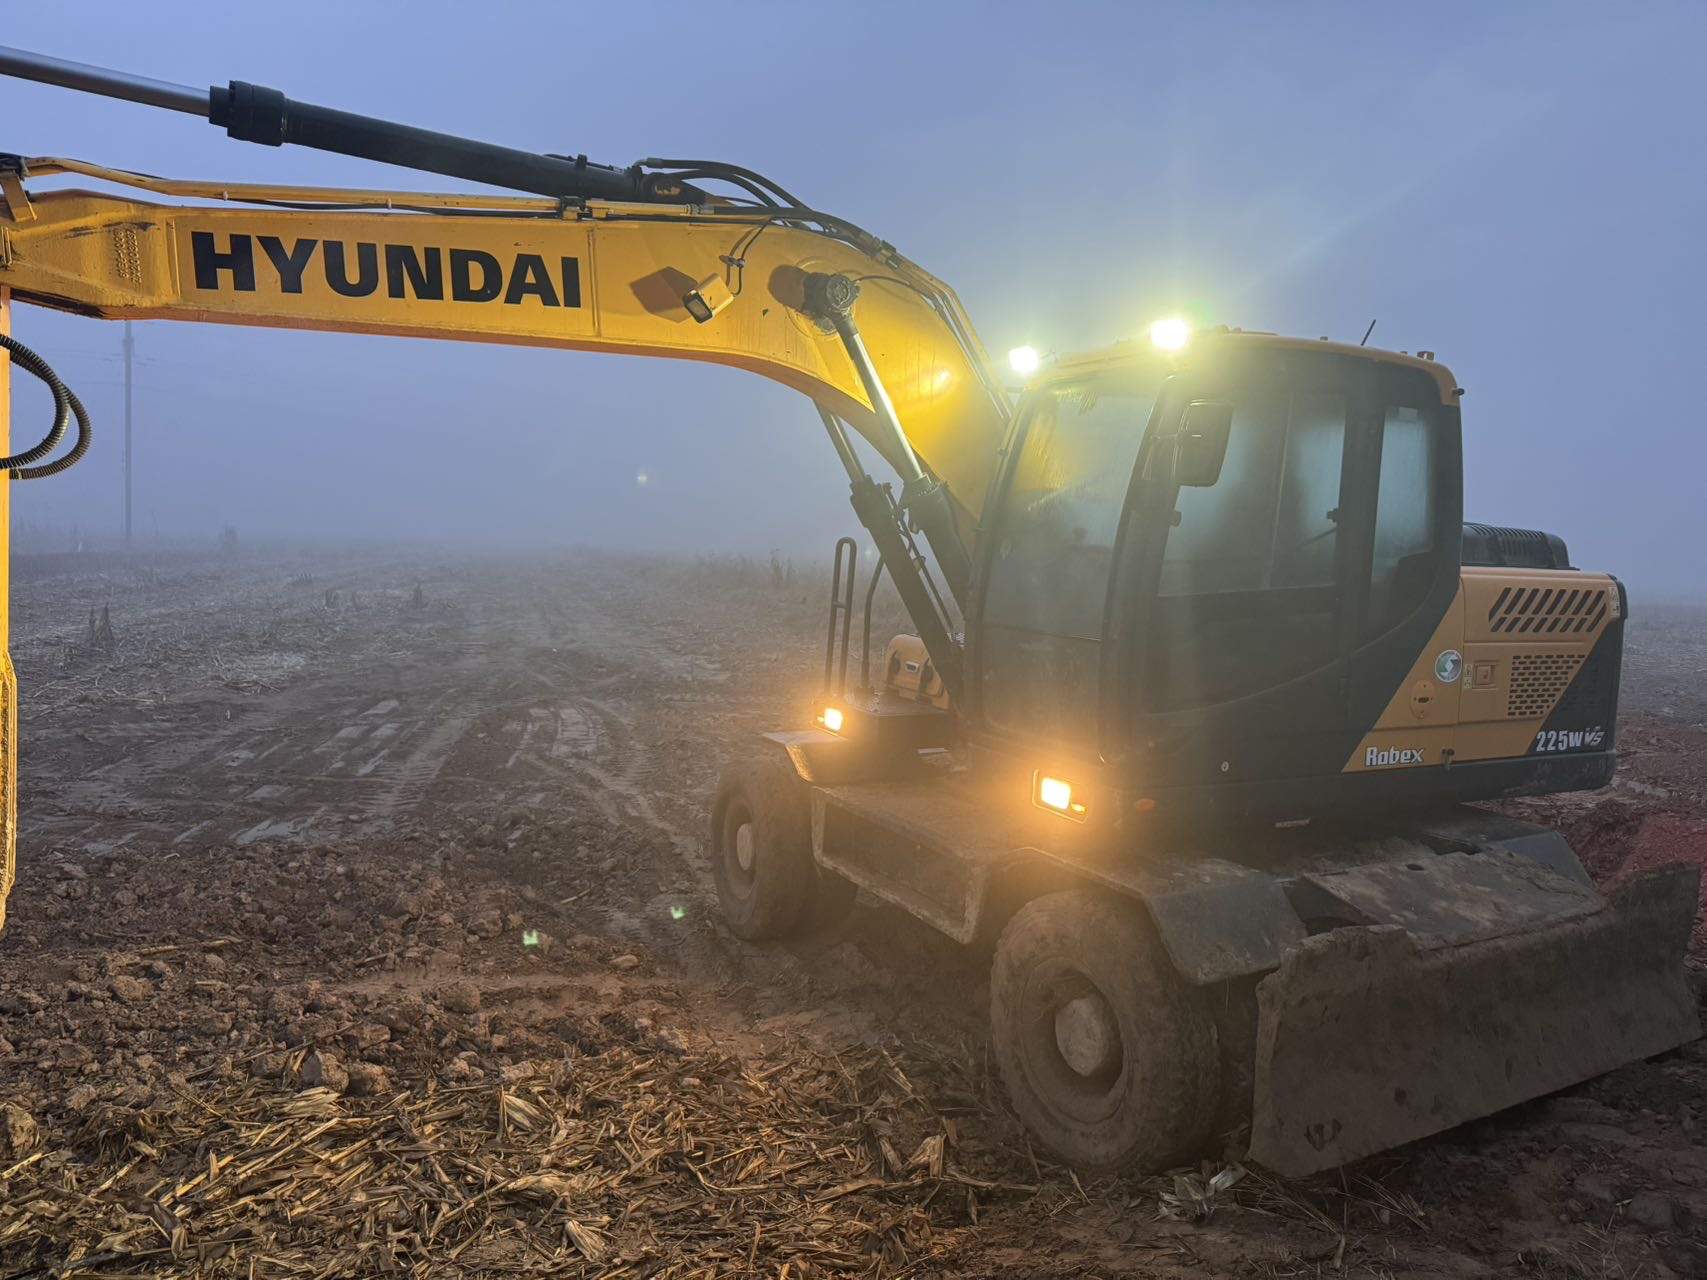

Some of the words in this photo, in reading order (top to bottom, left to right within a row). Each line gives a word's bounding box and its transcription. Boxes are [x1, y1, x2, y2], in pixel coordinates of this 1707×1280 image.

[190, 231, 581, 308] HYUNDAI
[1536, 730, 1584, 752] 225W
[1365, 745, 1424, 767] Robex
